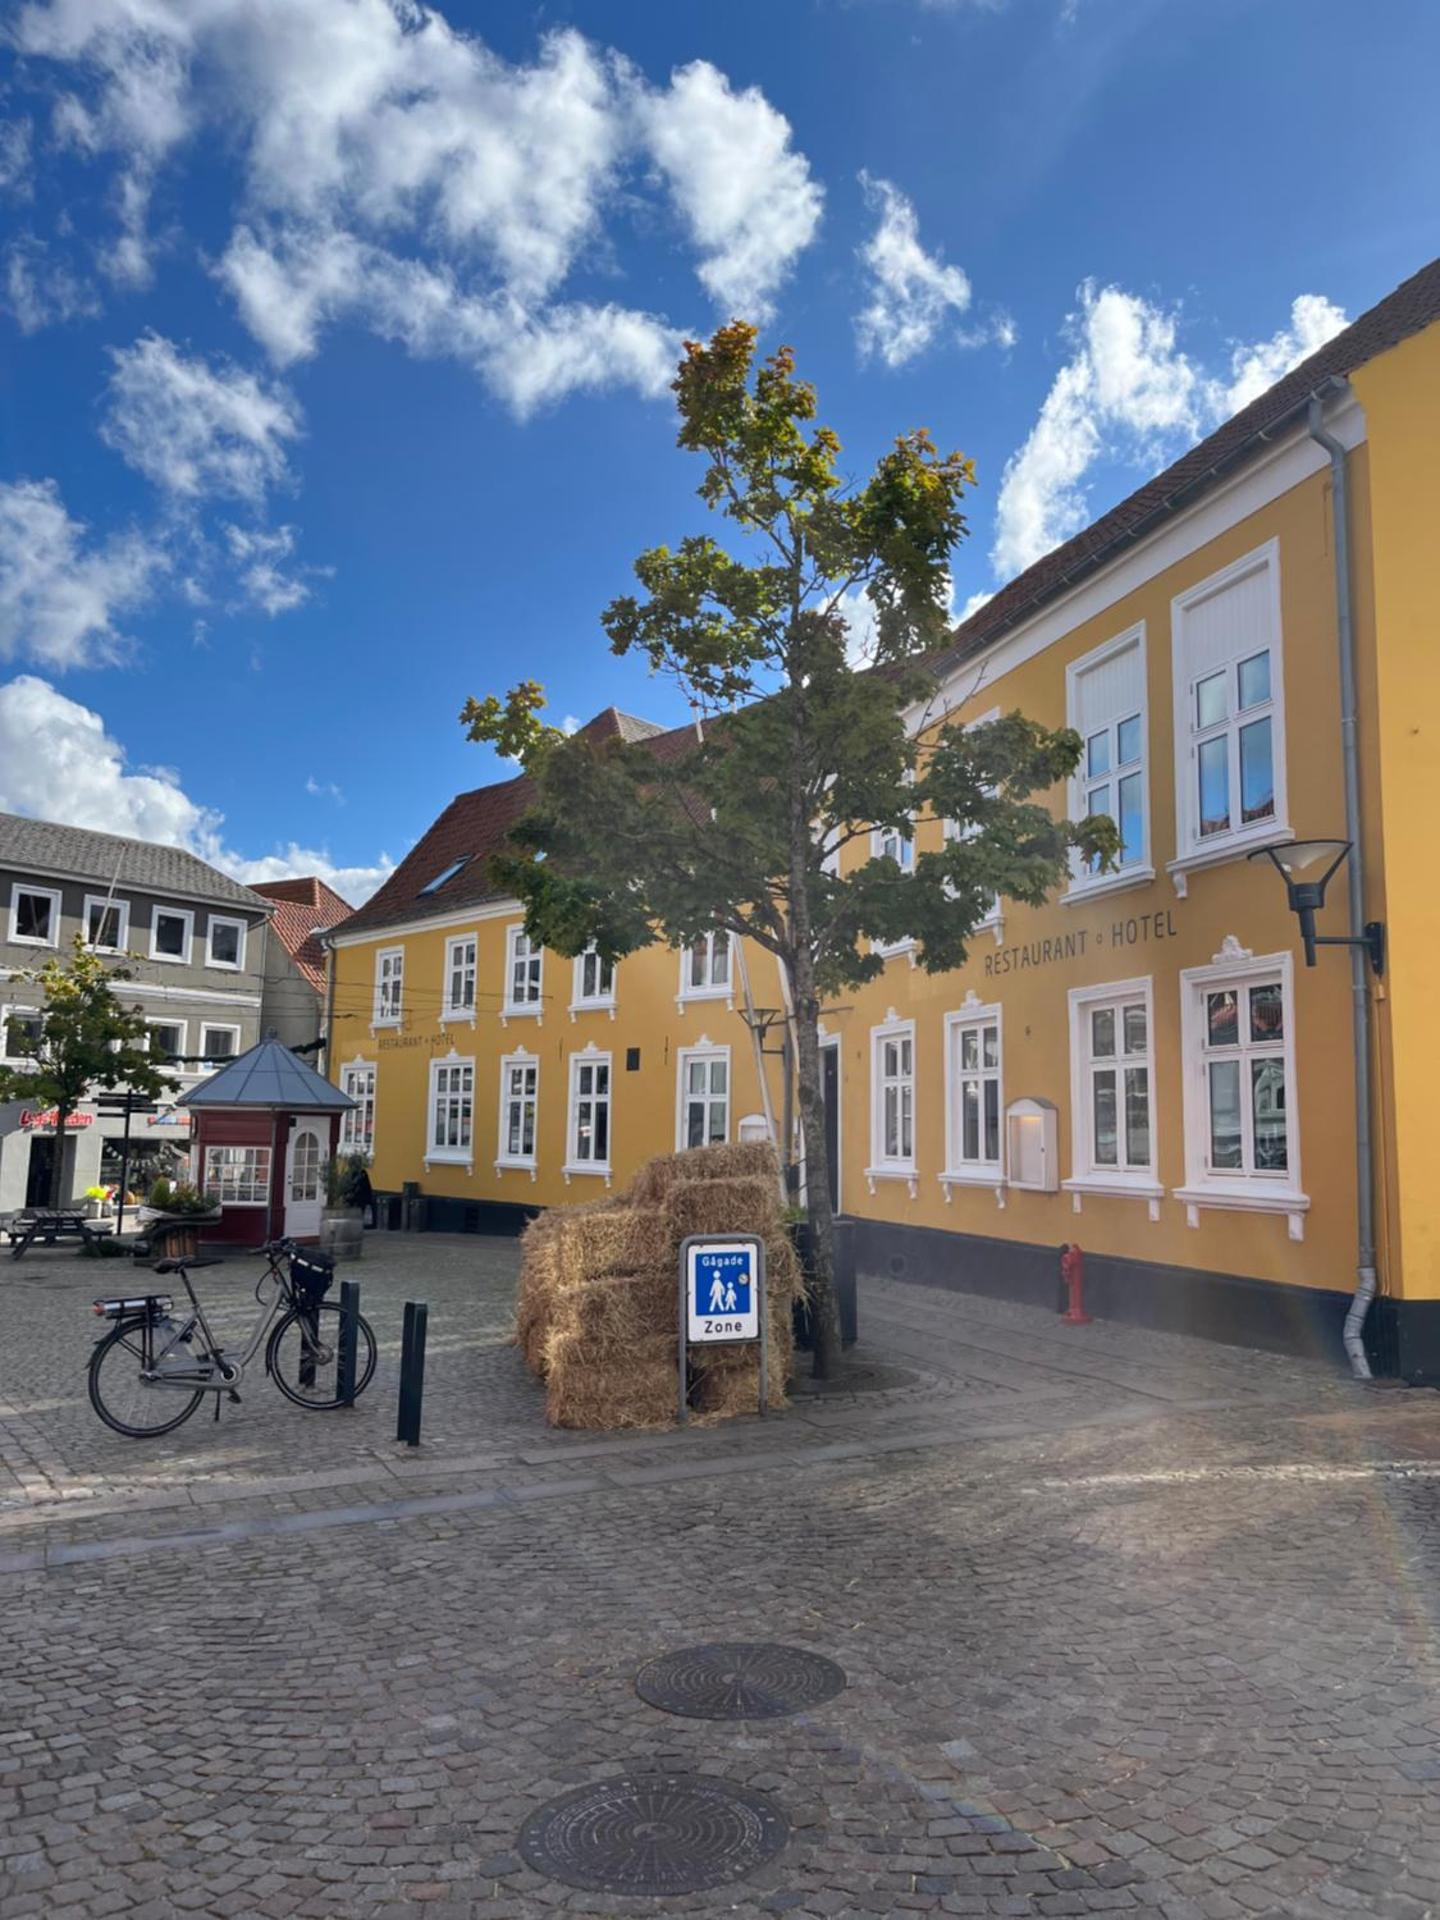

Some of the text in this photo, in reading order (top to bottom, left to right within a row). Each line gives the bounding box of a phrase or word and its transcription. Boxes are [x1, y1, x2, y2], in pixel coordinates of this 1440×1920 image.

[984, 911, 1177, 977] RESTAURANT HOTEL
[701, 1255, 744, 1268] Gågade
[704, 1320, 743, 1334] Zone
